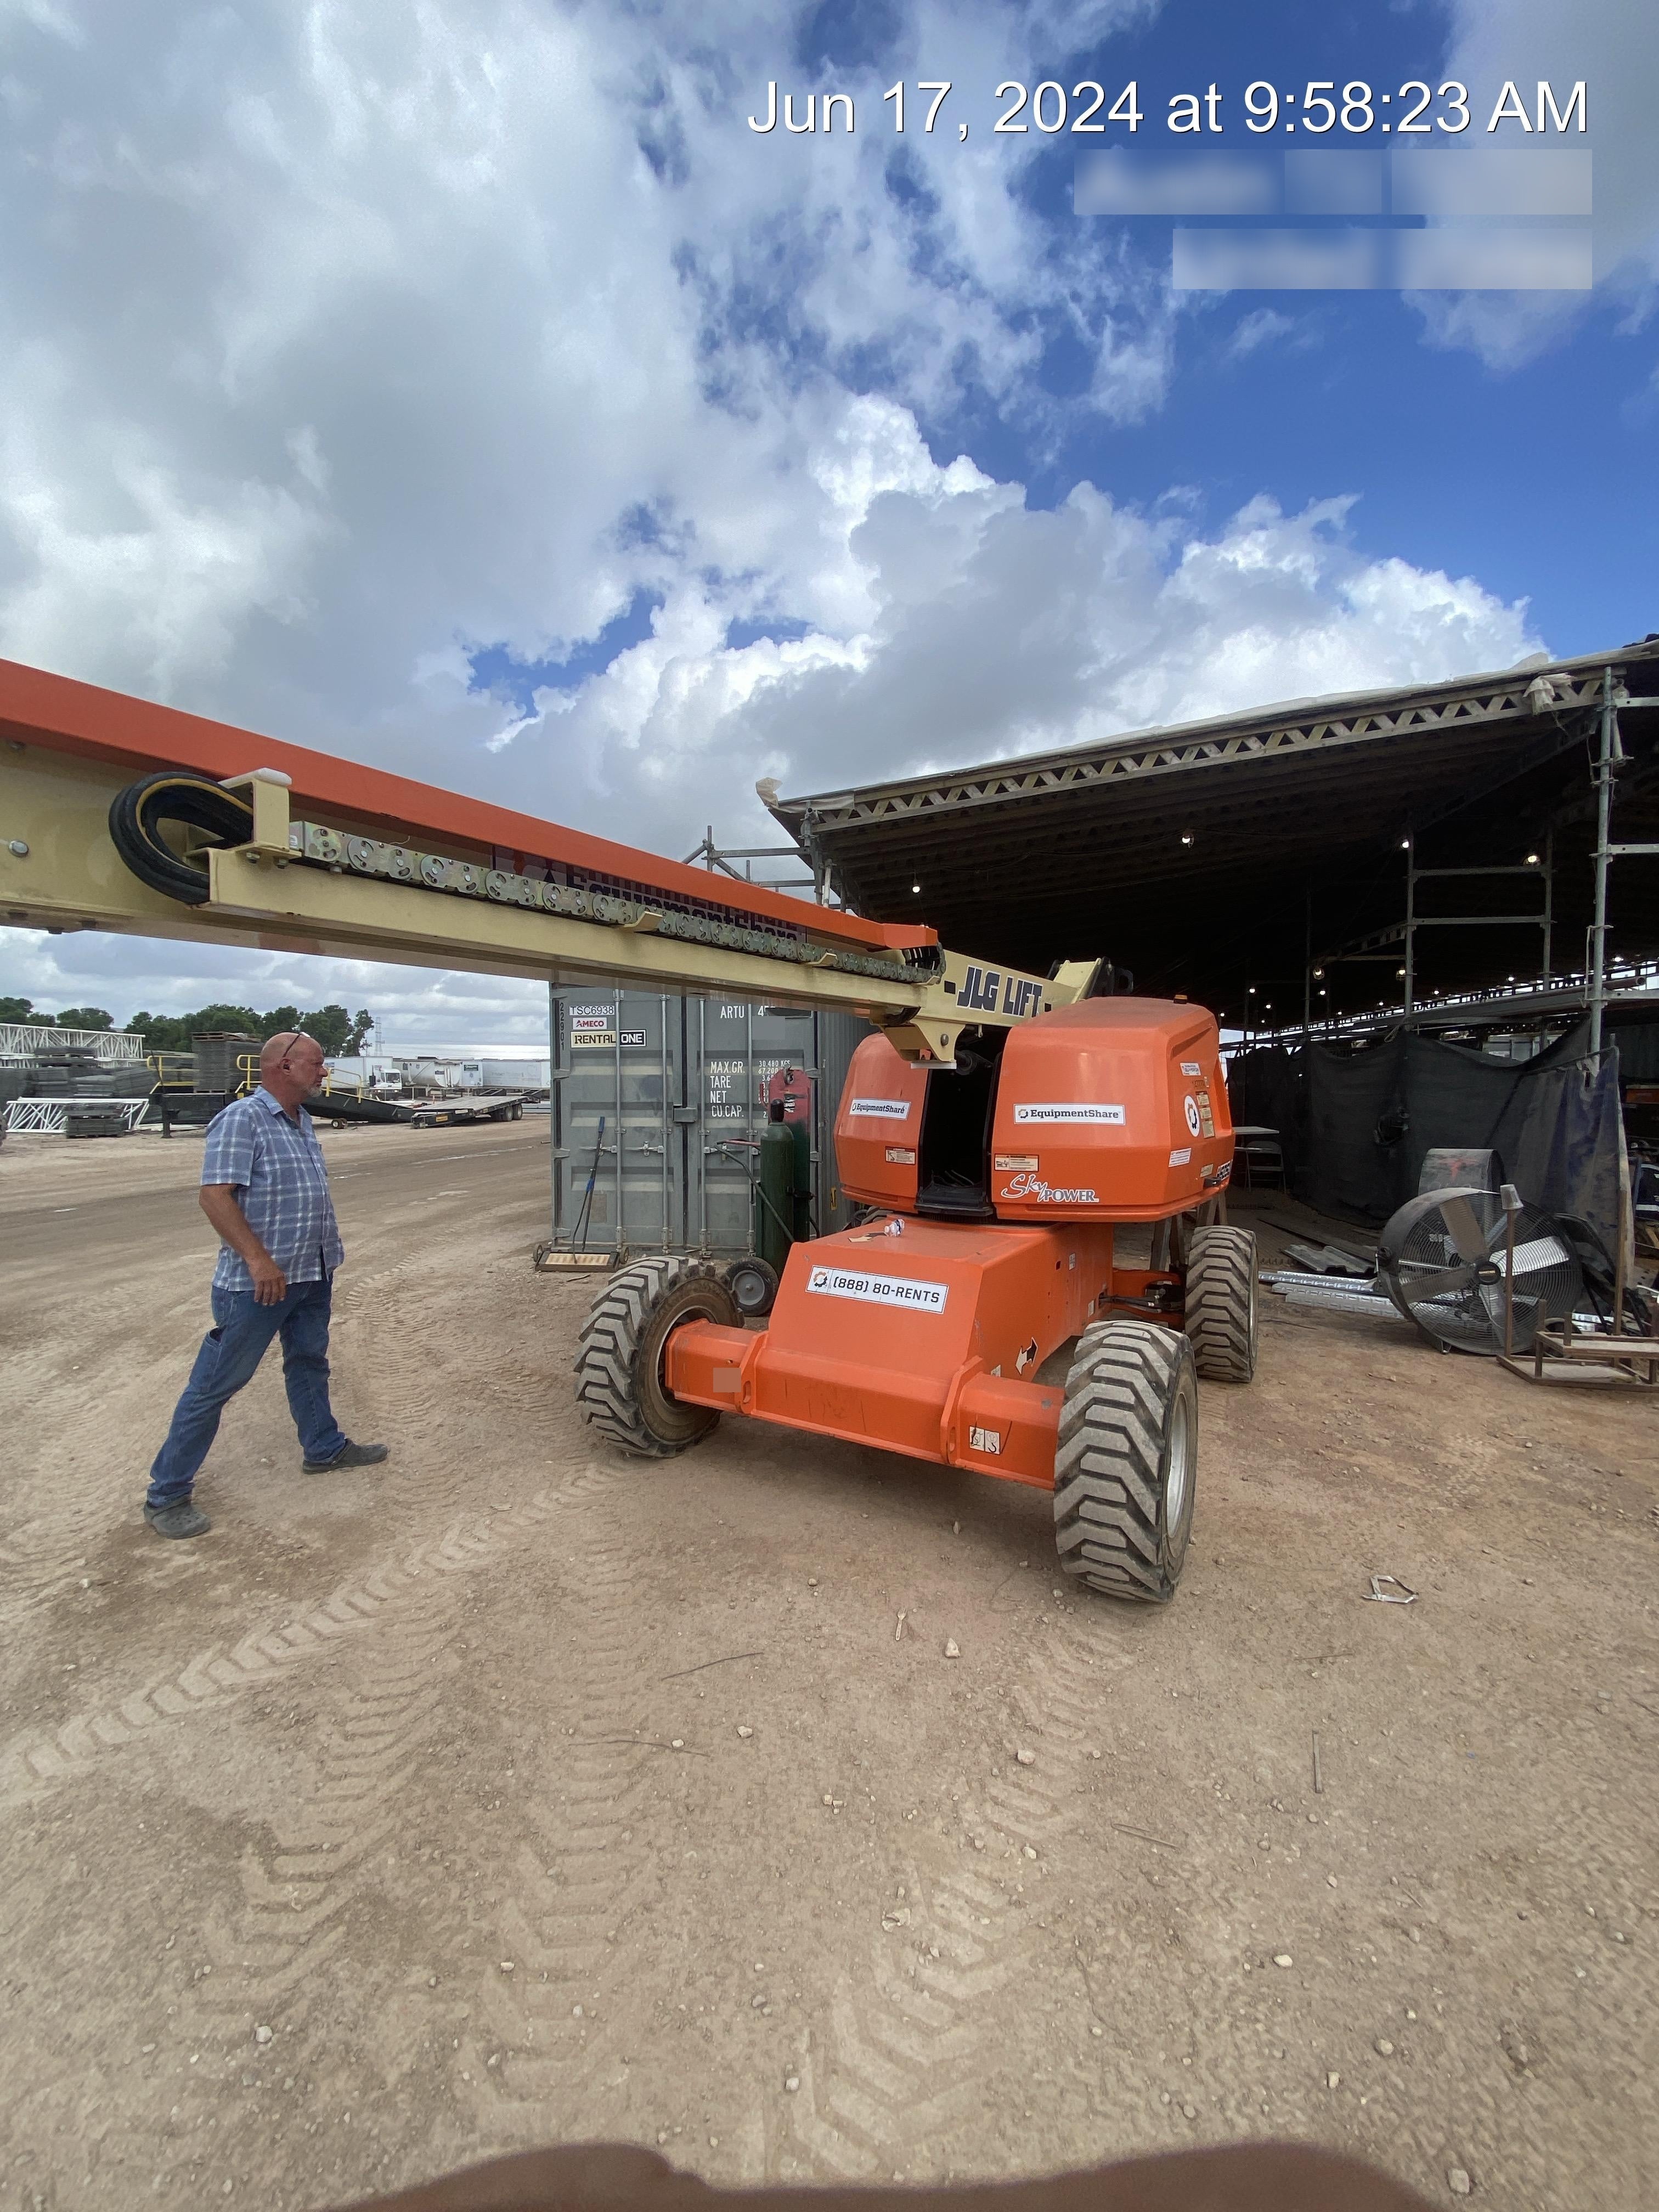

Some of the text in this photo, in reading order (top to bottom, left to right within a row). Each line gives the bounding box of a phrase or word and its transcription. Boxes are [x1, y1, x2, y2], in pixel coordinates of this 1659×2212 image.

[957, 965, 1043, 1018] JLG LIFT
[570, 1006, 614, 1015] TSC6938
[720, 1006, 744, 1018] ARTU
[574, 1034, 642, 1044] RENTAL ONE
[710, 1075, 731, 1088] TARE
[710, 1091, 727, 1103] NET
[712, 1105, 744, 1118] CU.CAP.
[1030, 1109, 1119, 1119] EquipmentShare
[1043, 1189, 1095, 1202] POWER
[833, 1276, 940, 1303] (888) 80-RENTS
